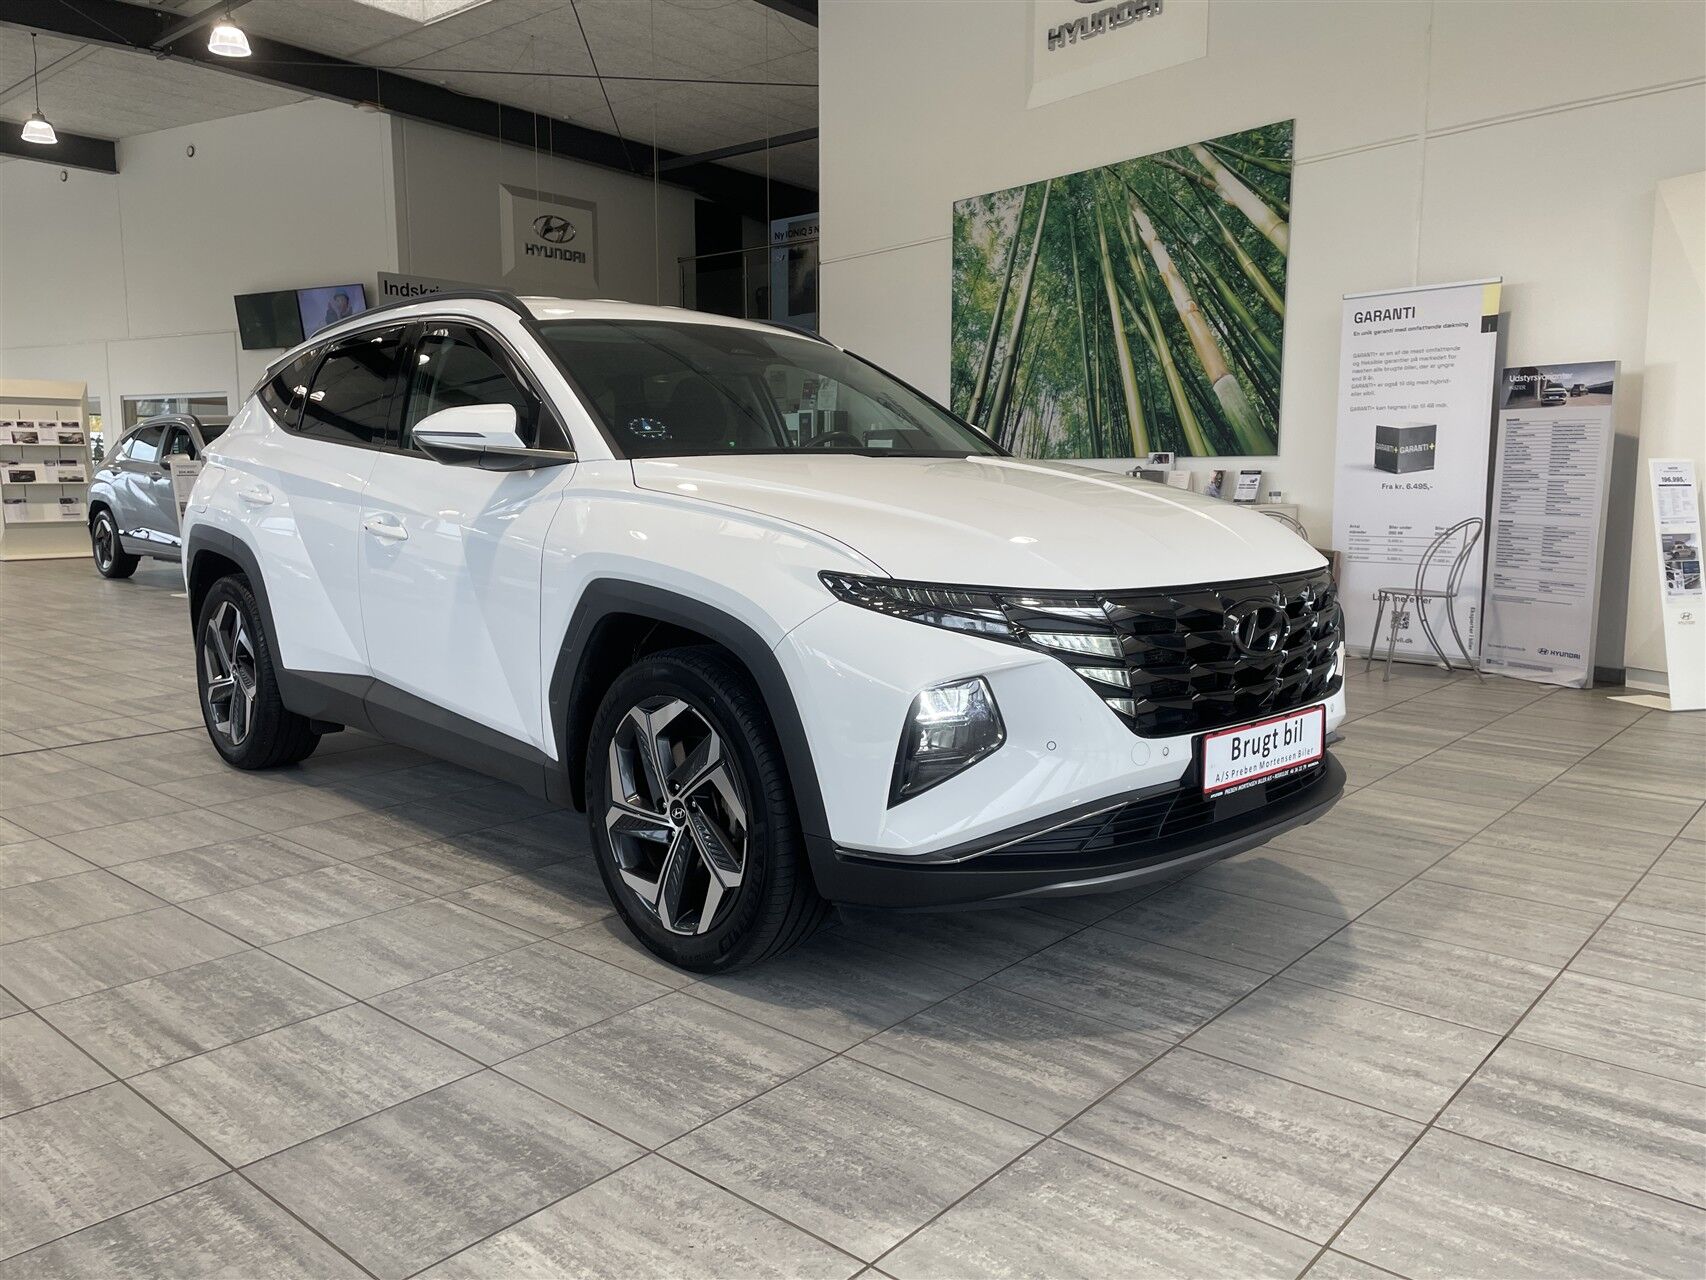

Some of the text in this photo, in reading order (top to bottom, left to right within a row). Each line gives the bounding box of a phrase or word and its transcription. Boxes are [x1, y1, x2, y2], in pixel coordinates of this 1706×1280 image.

[1048, 0, 1163, 51] HYUNDAI
[774, 231, 784, 240] Ny
[786, 228, 807, 238] IONIQ
[808, 226, 813, 235] 5
[525, 242, 586, 264] HYUNDAI
[1354, 306, 1416, 324] GARANTI
[1373, 328, 1394, 336] garanti
[1407, 323, 1442, 332] omfattende
[1406, 482, 1433, 491] 6.495,-
[1549, 650, 1581, 660] HYUNDAI
[1231, 718, 1304, 761] Brugt bil
[1215, 770, 1230, 783] A/S
[1231, 763, 1258, 778] Preben
[1259, 752, 1297, 770] Mortensen
[1297, 746, 1315, 760] Biler
